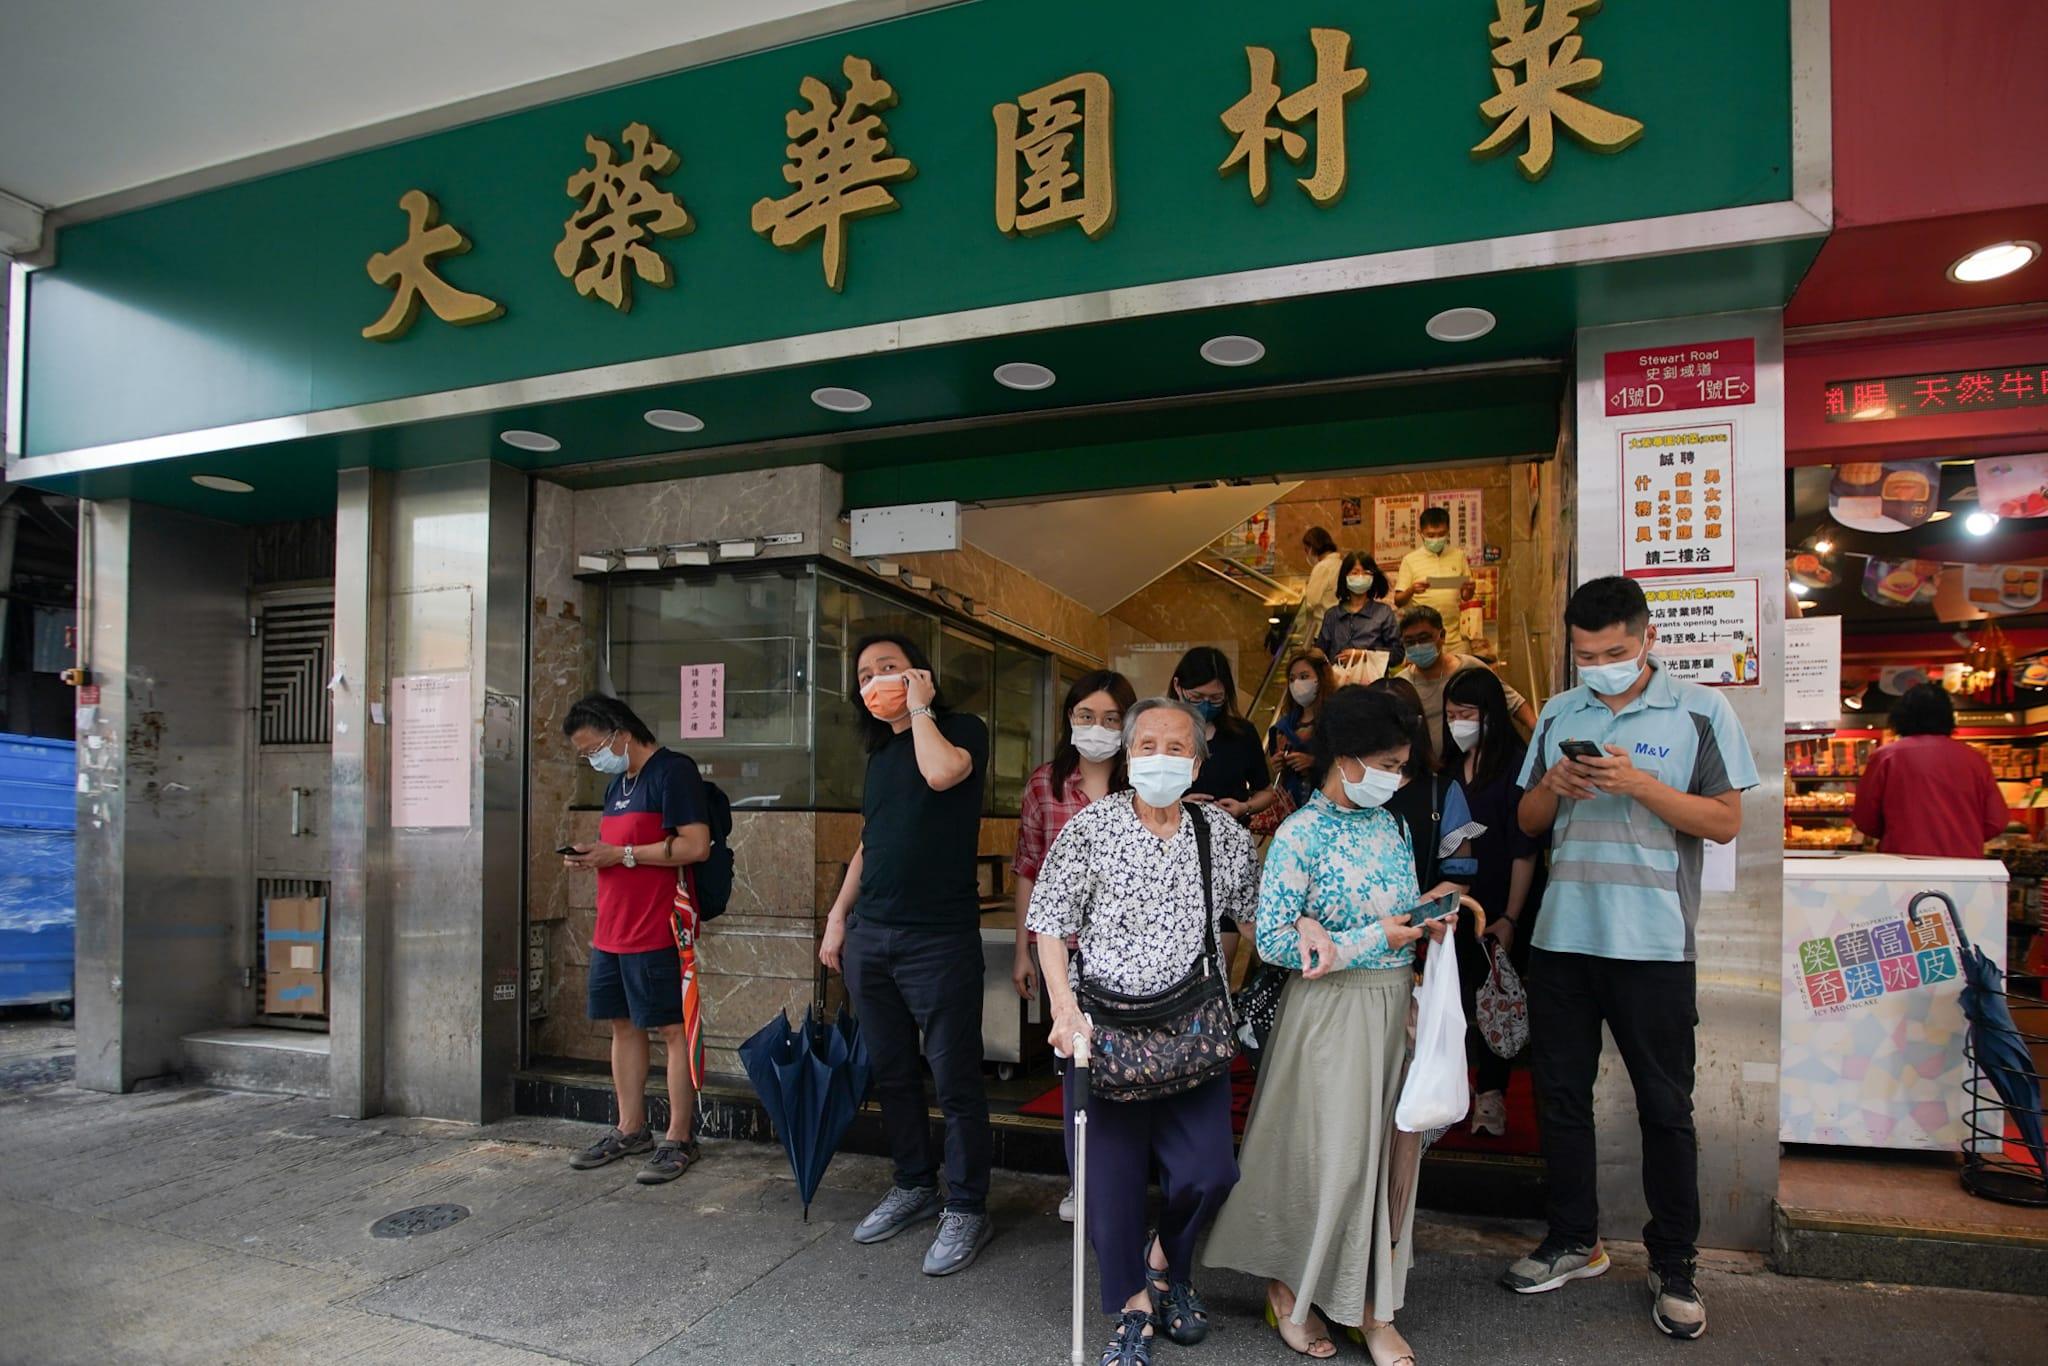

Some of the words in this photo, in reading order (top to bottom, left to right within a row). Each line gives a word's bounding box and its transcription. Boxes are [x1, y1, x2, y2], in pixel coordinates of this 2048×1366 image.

[362, 0, 1644, 340] 大榮華圍村菜
[1639, 353, 1685, 366] Stewart
[1690, 350, 1719, 361] Road
[1646, 362, 1712, 381] 史釗域道
[1619, 384, 1665, 409] 1號D
[1696, 376, 1742, 402] 1號E
[1913, 368, 2048, 408] 天然牛
[1683, 619, 1718, 628] opening
[1663, 658, 1714, 671] 光臨惠顧
[1635, 742, 1670, 758] M&V
[1803, 917, 1943, 974] 榮華富貴
[1808, 951, 1954, 1006] 香港冰皮
